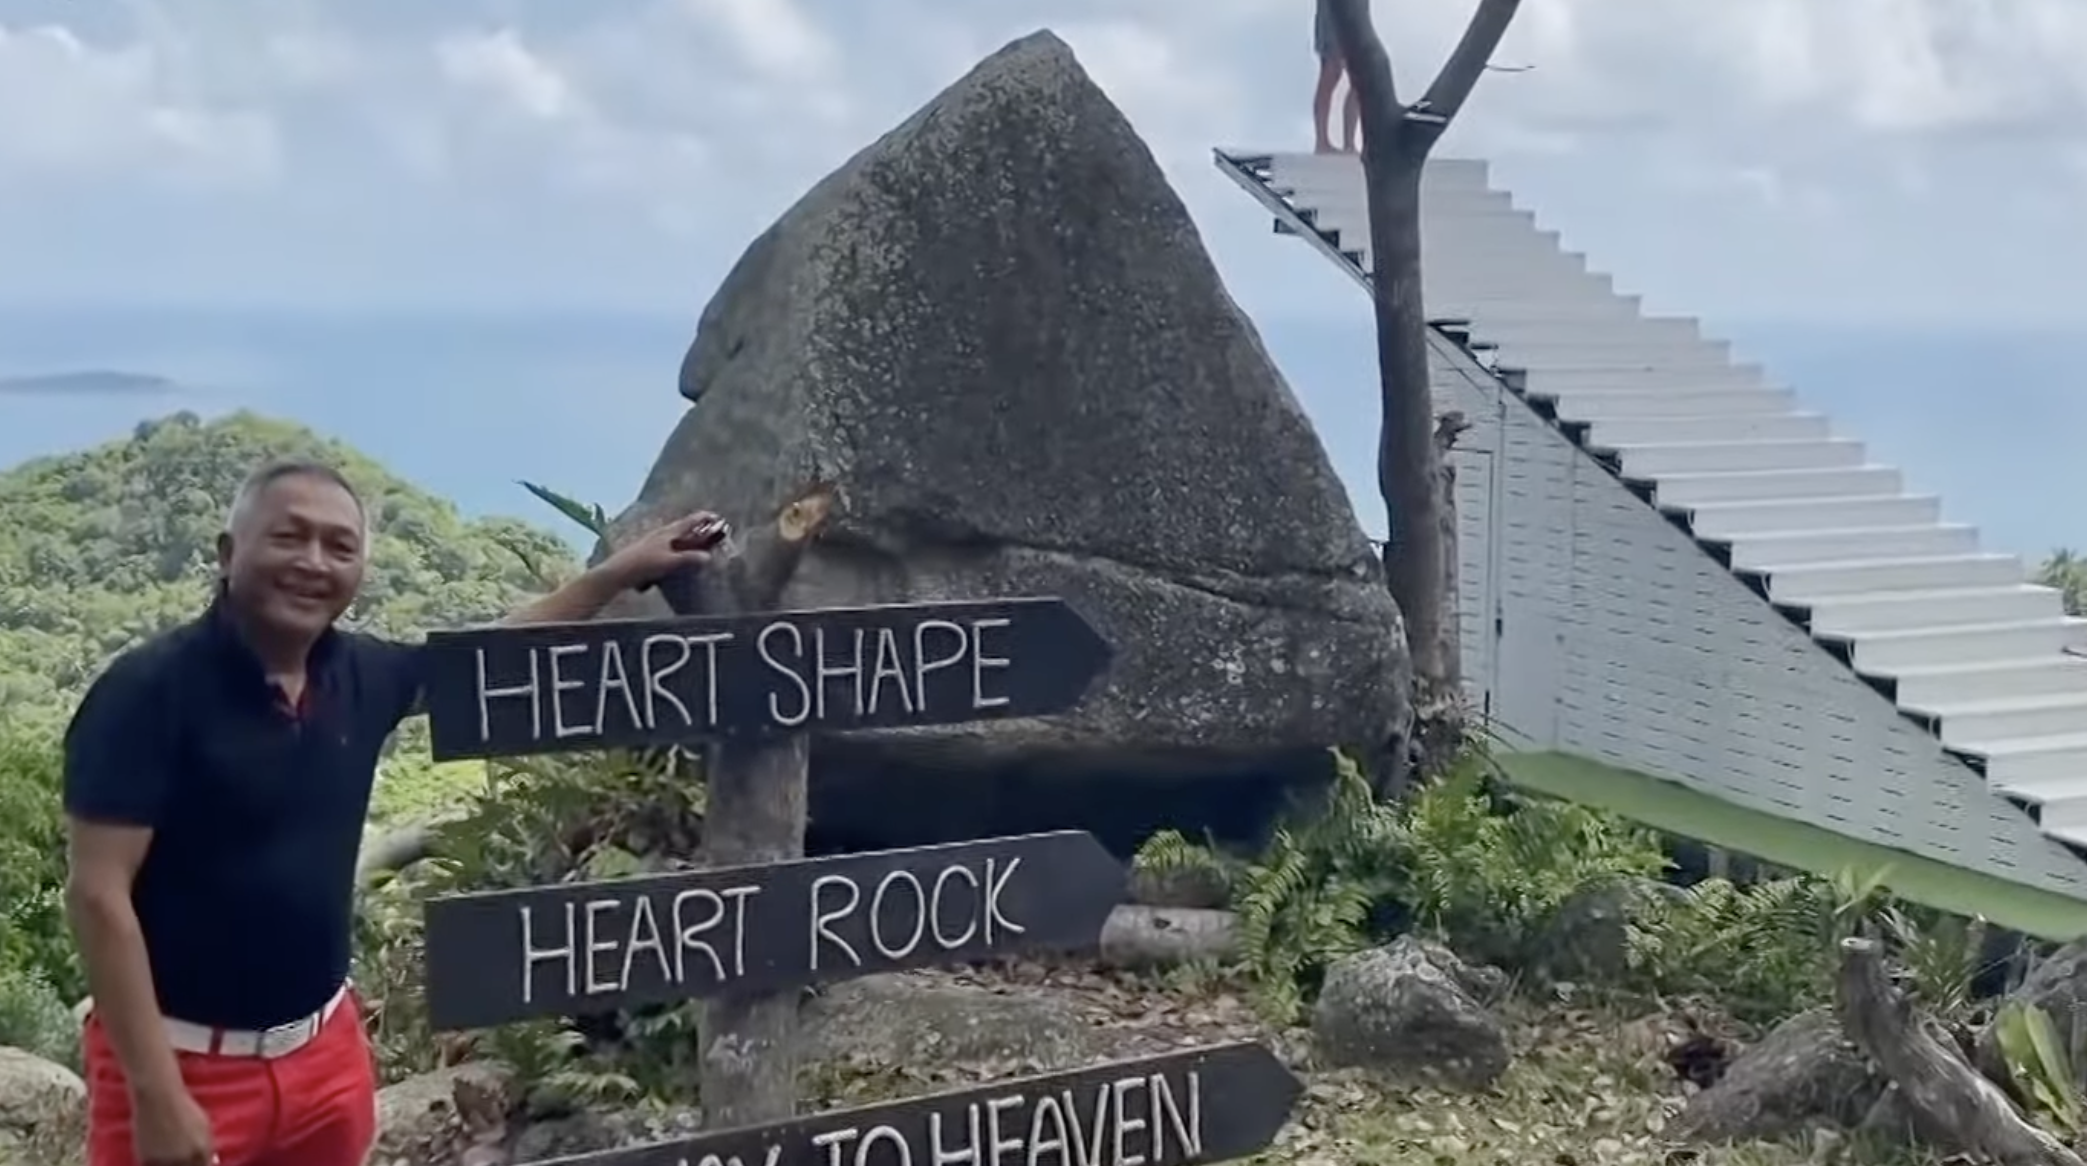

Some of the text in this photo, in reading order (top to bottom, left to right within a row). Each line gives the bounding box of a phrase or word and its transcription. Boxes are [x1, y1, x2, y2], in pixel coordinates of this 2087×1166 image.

[476, 618, 1011, 741] HEART SHAPE
[520, 857, 1025, 1002] HEART ROCK
[930, 1072, 1201, 1166] HEAVEN
